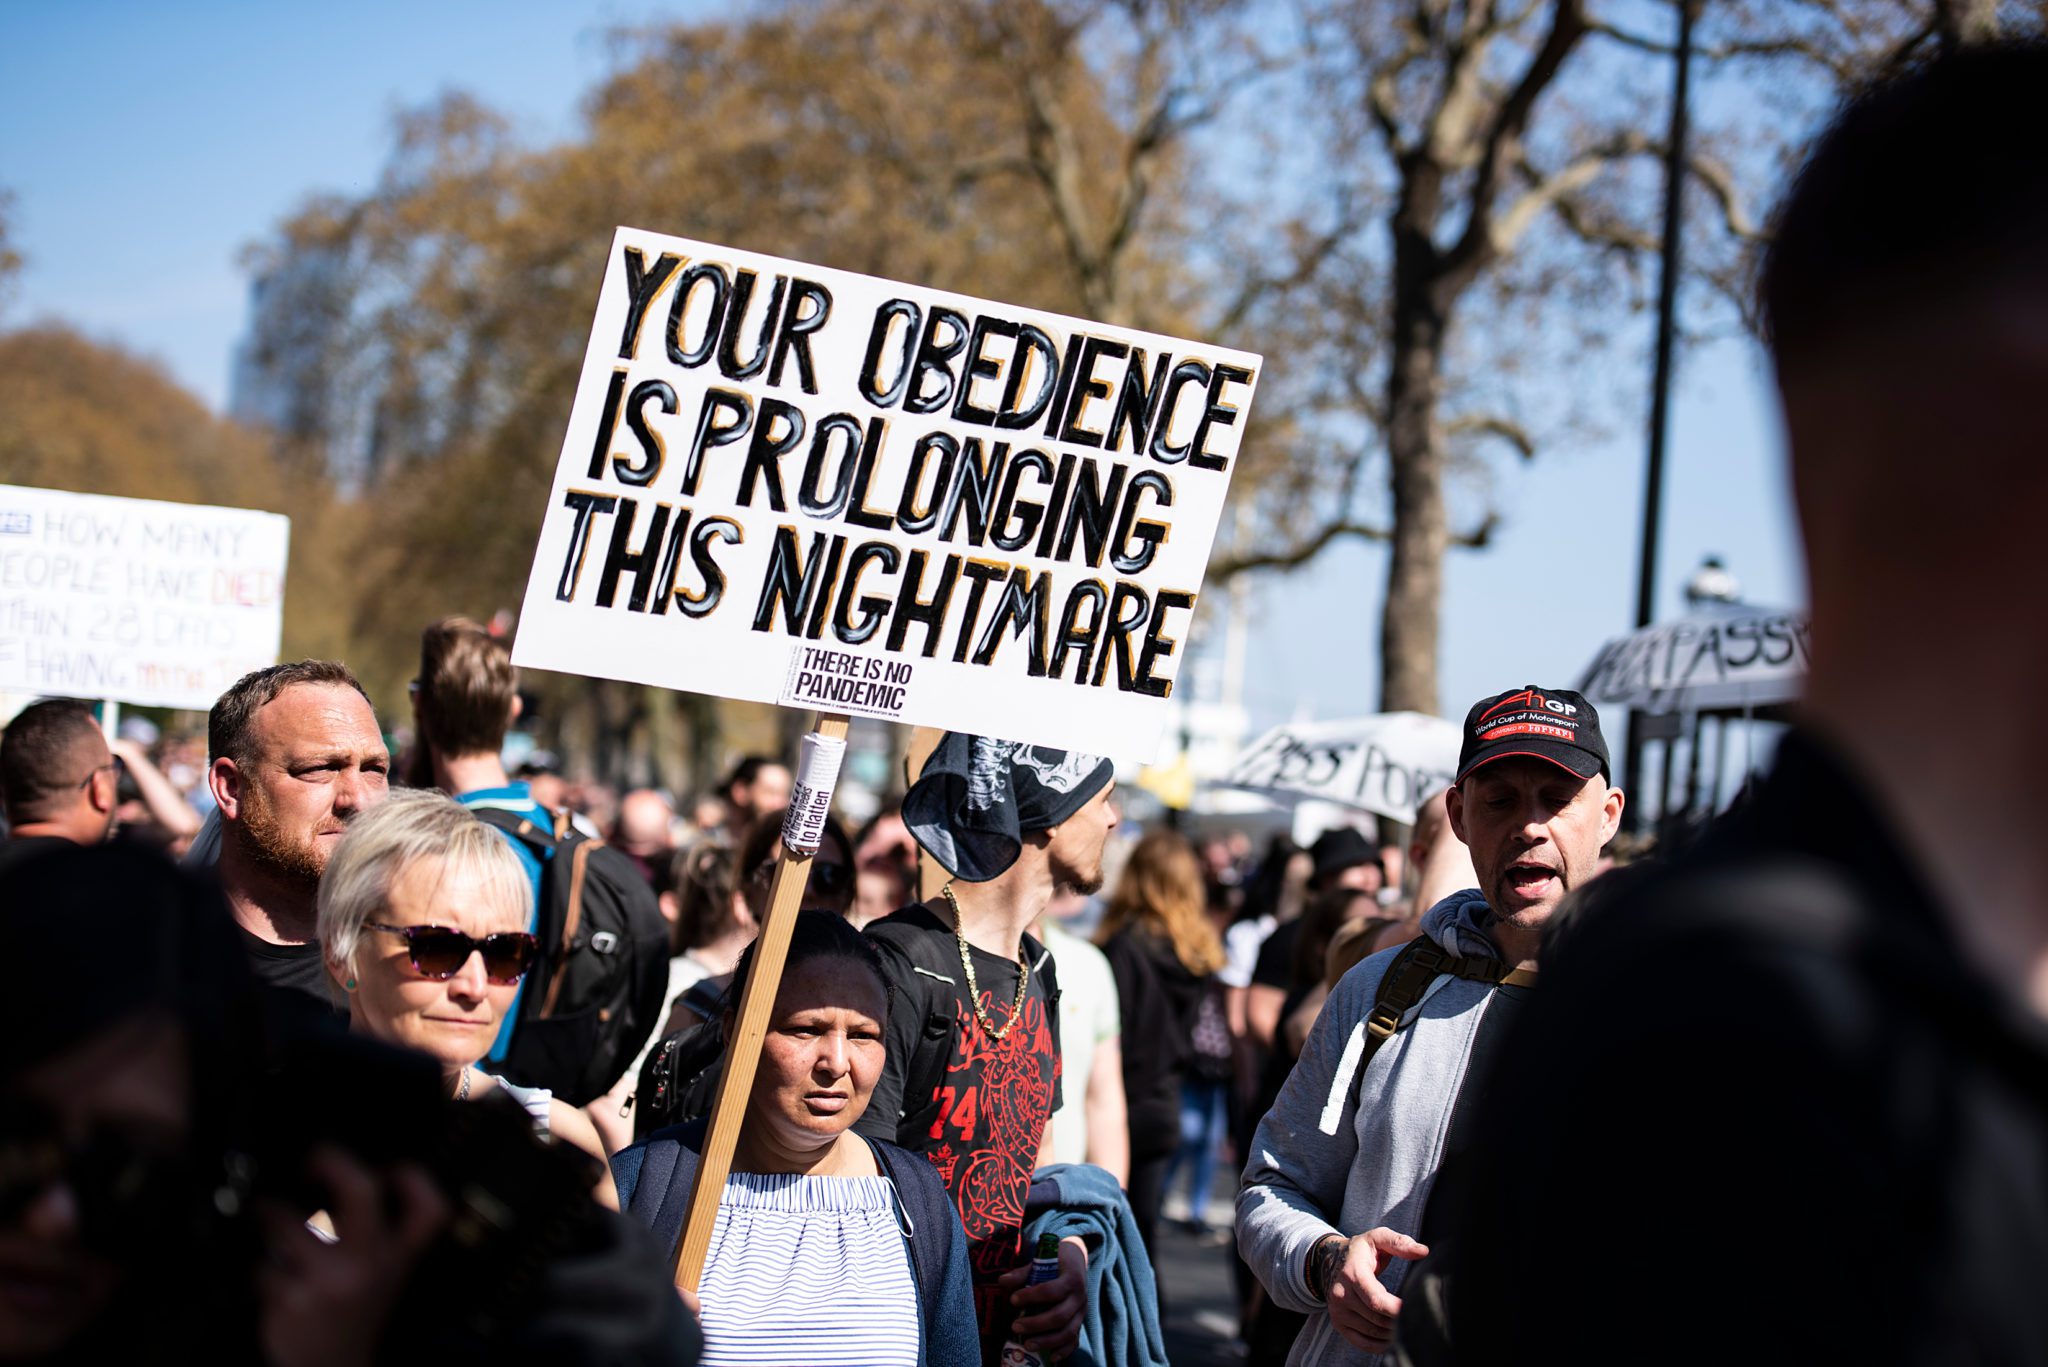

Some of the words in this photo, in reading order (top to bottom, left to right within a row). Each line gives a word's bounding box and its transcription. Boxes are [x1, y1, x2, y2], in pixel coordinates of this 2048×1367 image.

[618, 246, 833, 395] YOUR
[858, 298, 1256, 472] OBEDIENCE
[587, 366, 680, 488] IS
[681, 386, 1177, 575] PROLONGING
[43, 510, 128, 548] HOW
[143, 520, 248, 558] MANY
[0, 547, 113, 595] EOPLE
[126, 559, 207, 604] HAVE
[556, 488, 744, 620] THIS
[752, 523, 1198, 699] NIGHTMARE
[804, 648, 862, 677] THERE
[863, 658, 882, 681] IS
[884, 661, 913, 684] NO
[795, 672, 906, 710] PANDEMIC
[1475, 717, 1496, 736] World
[1497, 715, 1515, 725] Cup
[1517, 712, 1528, 720] of
[790, 811, 804, 831] three
[797, 786, 812, 811] weeks
[804, 791, 829, 828] flatten
[799, 831, 817, 842] to
[928, 1086, 977, 1140] 74
